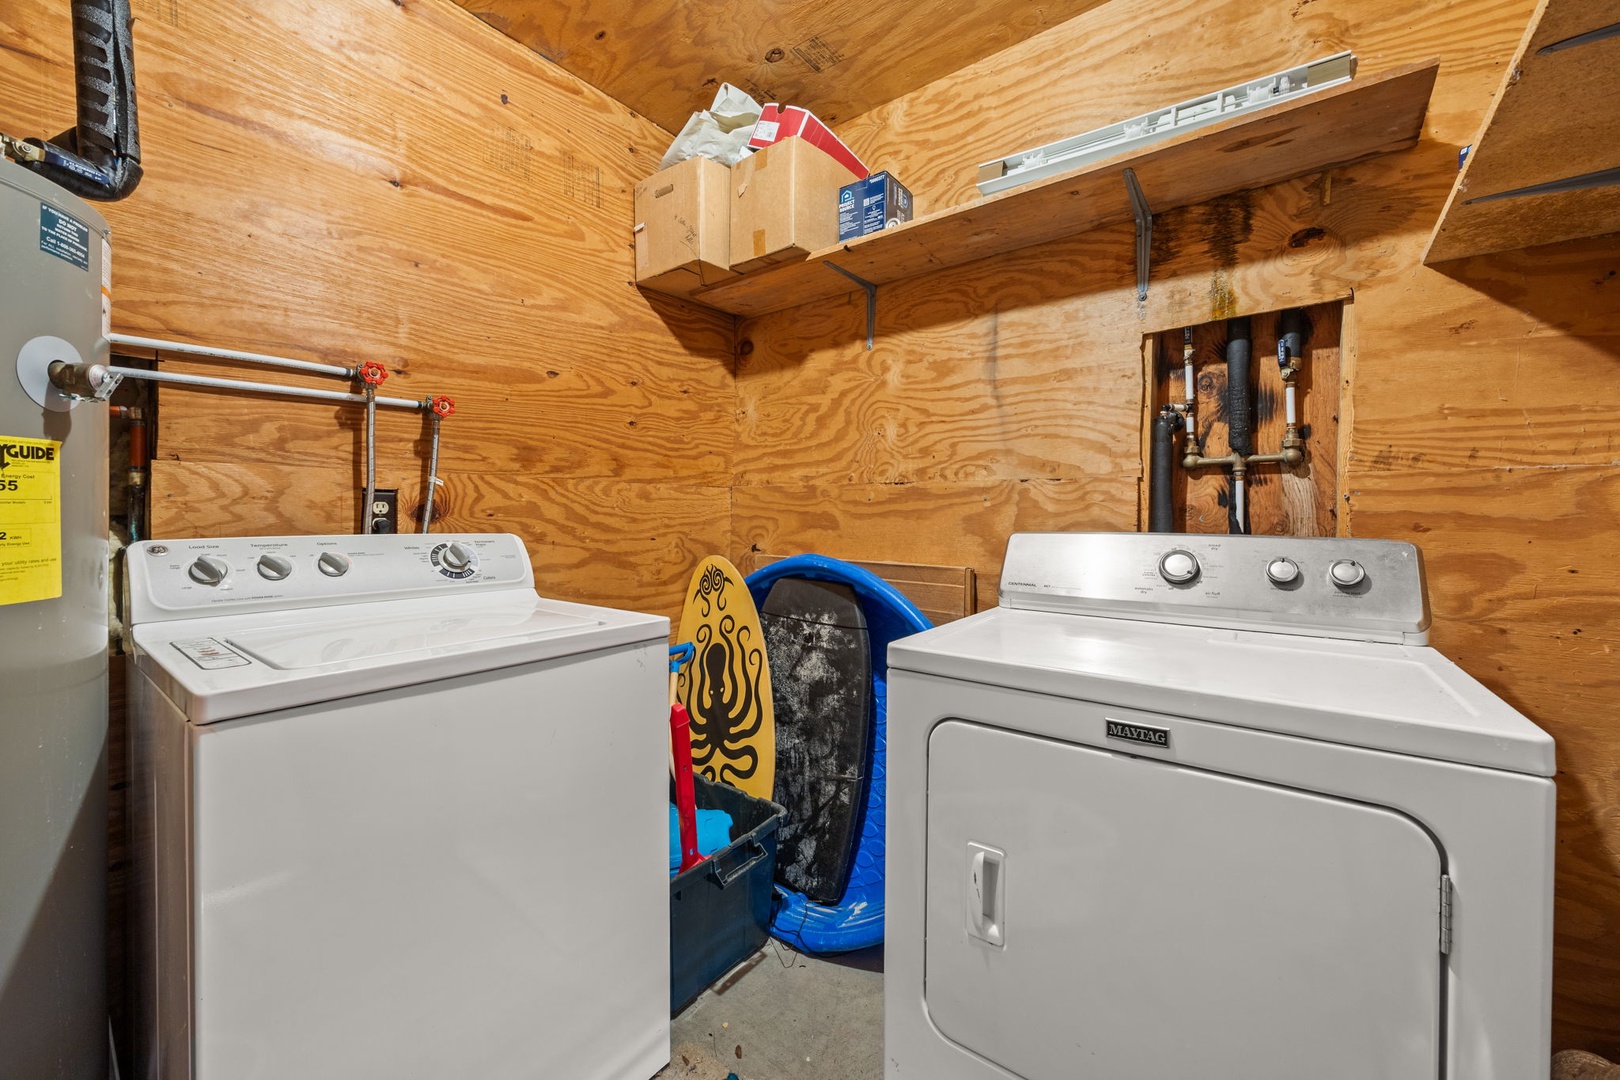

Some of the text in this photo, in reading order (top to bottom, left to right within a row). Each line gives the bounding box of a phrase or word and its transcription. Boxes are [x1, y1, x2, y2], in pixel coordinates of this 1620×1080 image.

[58, 218, 77, 232] DO NOT
[46, 236, 56, 244] Call
[1109, 724, 1166, 744] MAYTAG
